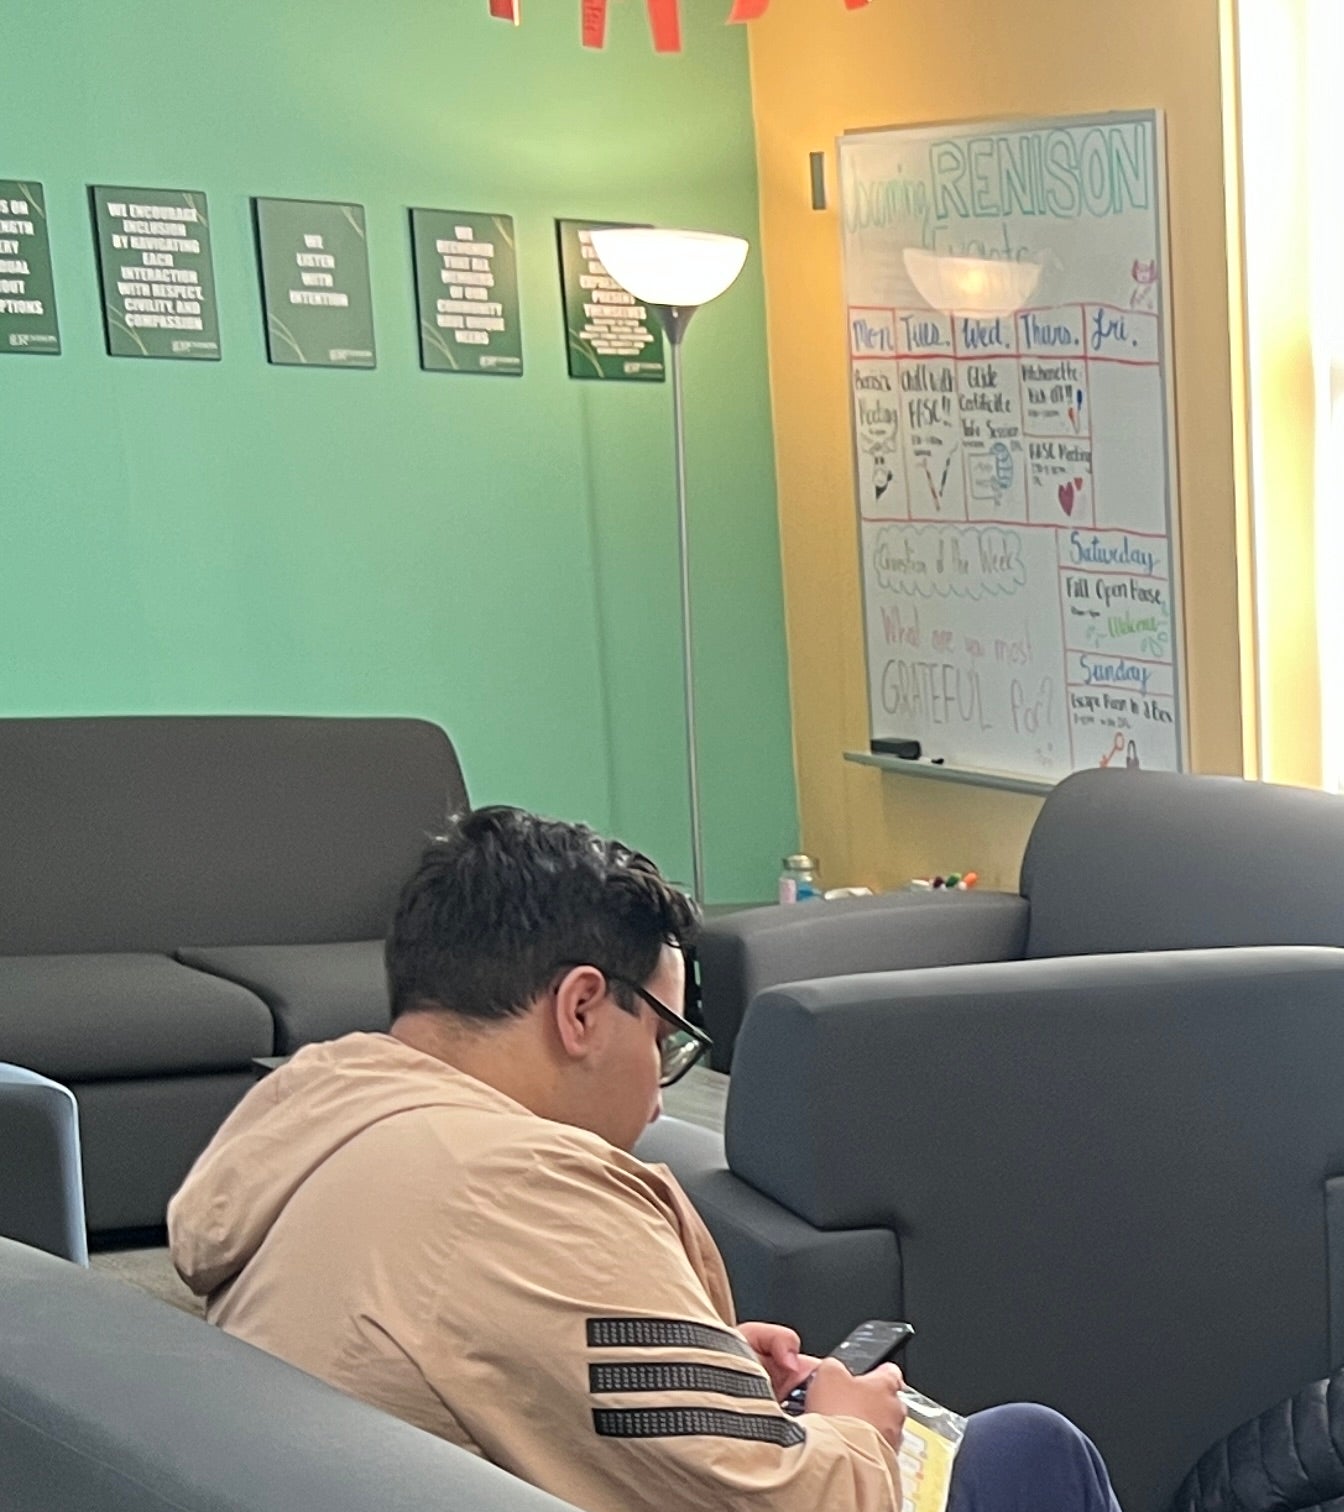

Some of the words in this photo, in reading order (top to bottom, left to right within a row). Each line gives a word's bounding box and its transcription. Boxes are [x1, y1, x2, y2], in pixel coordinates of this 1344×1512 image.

[929, 125, 1149, 219] RENISON
[112, 234, 128, 249] BY
[117, 282, 150, 296] WITH
[1020, 314, 1080, 349] Thurs.
[1070, 531, 1159, 574] Saturday
[1066, 576, 1089, 600] Fall
[1096, 578, 1128, 608] Open
[881, 659, 993, 731] GRATEFUL
[1080, 654, 1151, 697] Sunday
